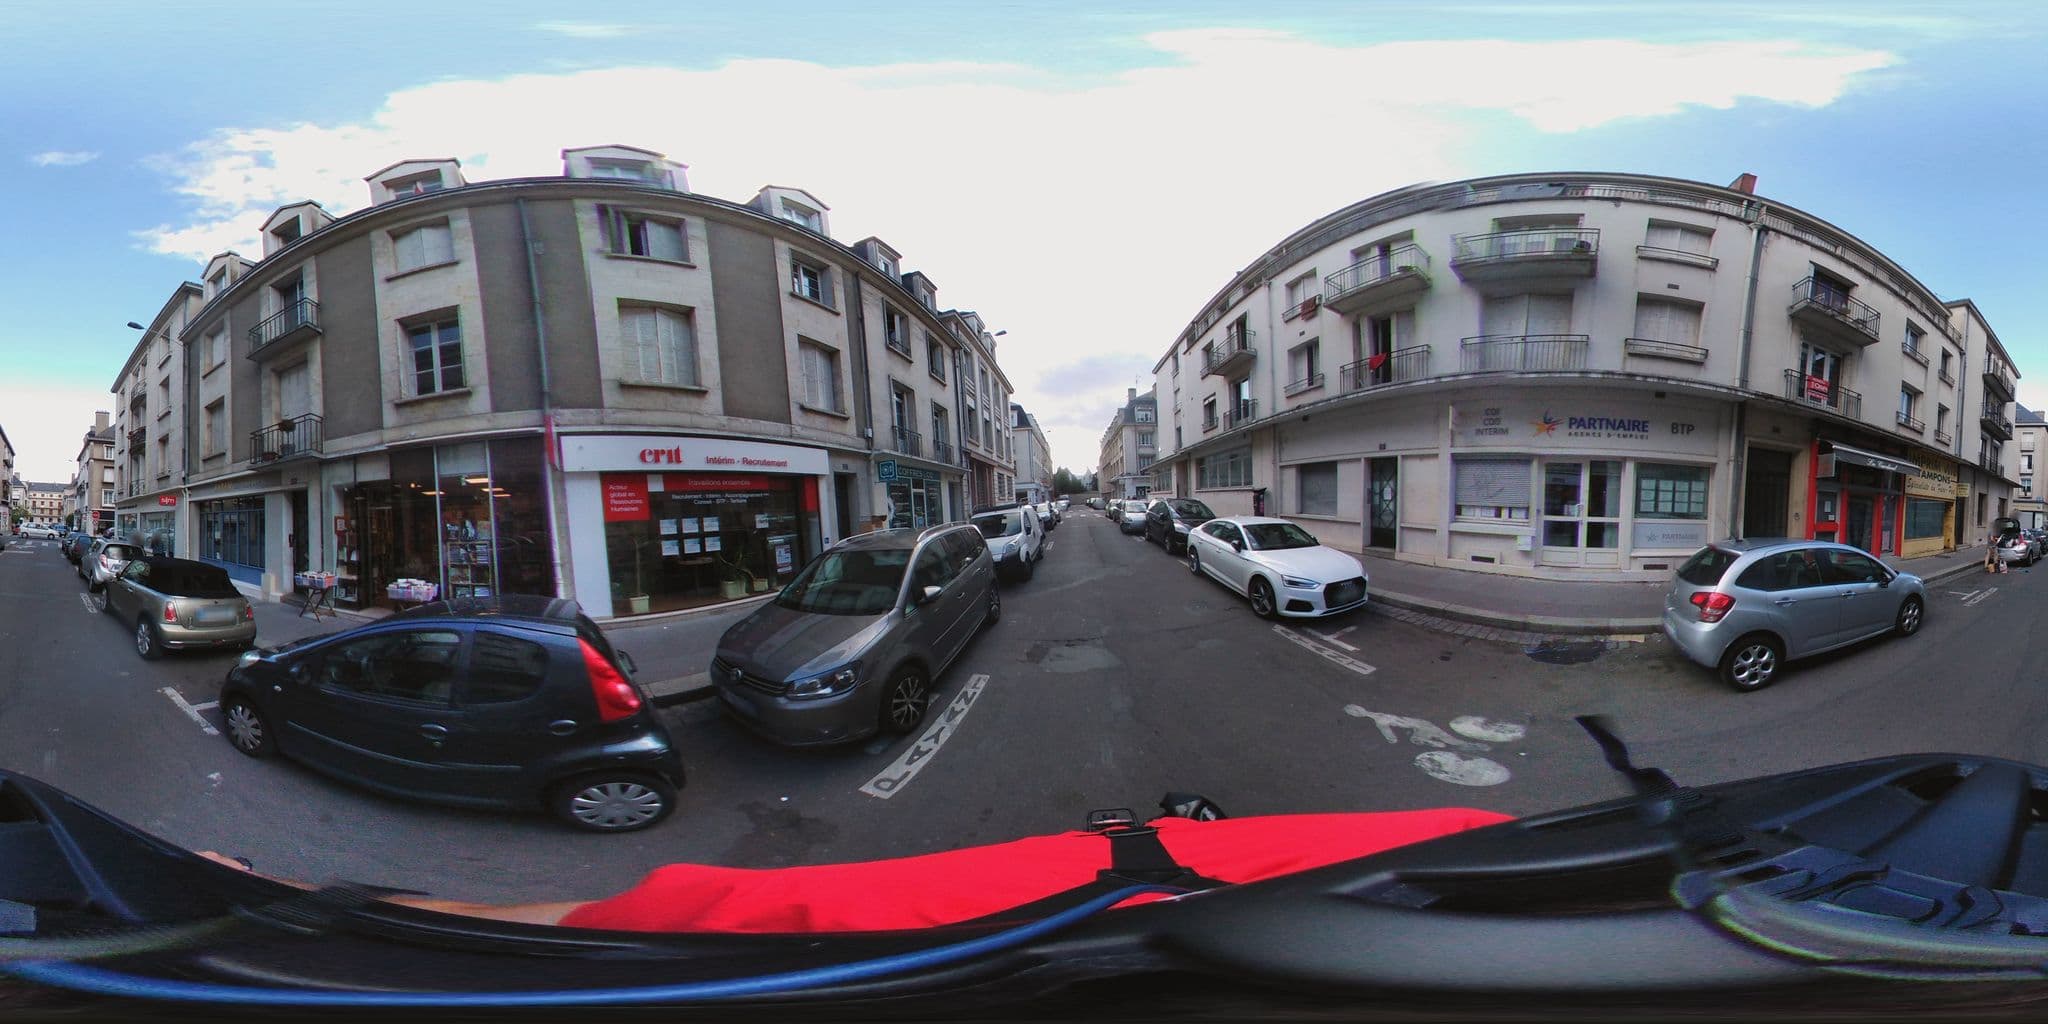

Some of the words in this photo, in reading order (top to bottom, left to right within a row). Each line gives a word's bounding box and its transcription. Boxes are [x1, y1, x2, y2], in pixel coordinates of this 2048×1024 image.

[1568, 416, 1649, 433] PARTNAIRE
[1671, 422, 1695, 436] BTP
[639, 445, 683, 465] crit
[706, 456, 735, 465] Intérim
[742, 456, 788, 468] Recrutement
[870, 675, 989, 794] PAYANT
